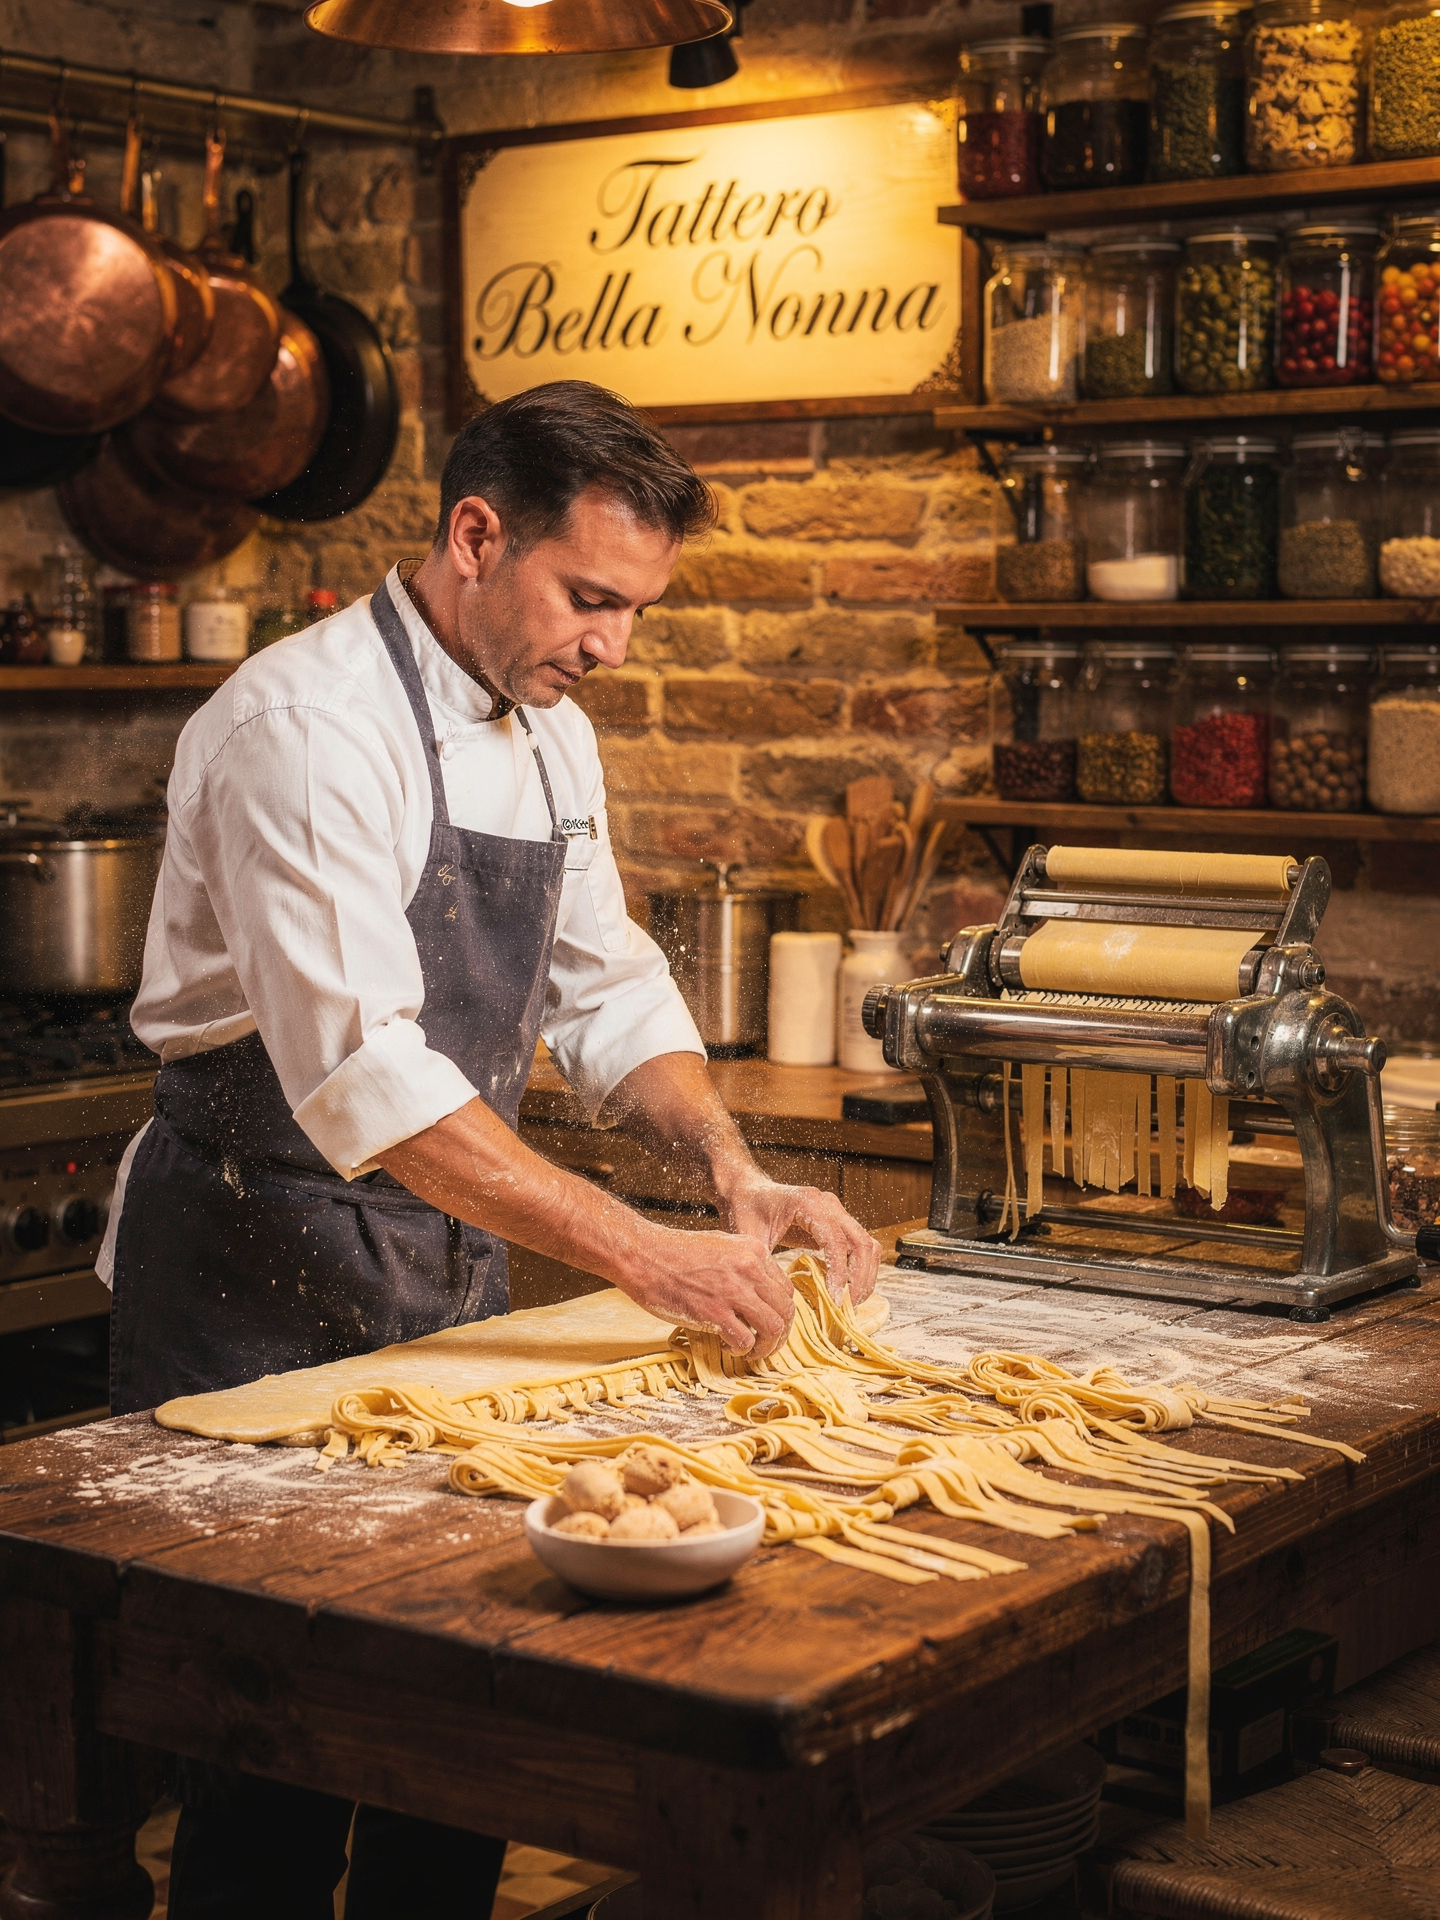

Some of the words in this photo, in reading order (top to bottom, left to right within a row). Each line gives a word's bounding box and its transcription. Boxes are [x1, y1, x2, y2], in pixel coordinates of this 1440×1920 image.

[589, 154, 834, 254] Tattero
[474, 261, 663, 359] Bella
[685, 245, 942, 345] Nonna
